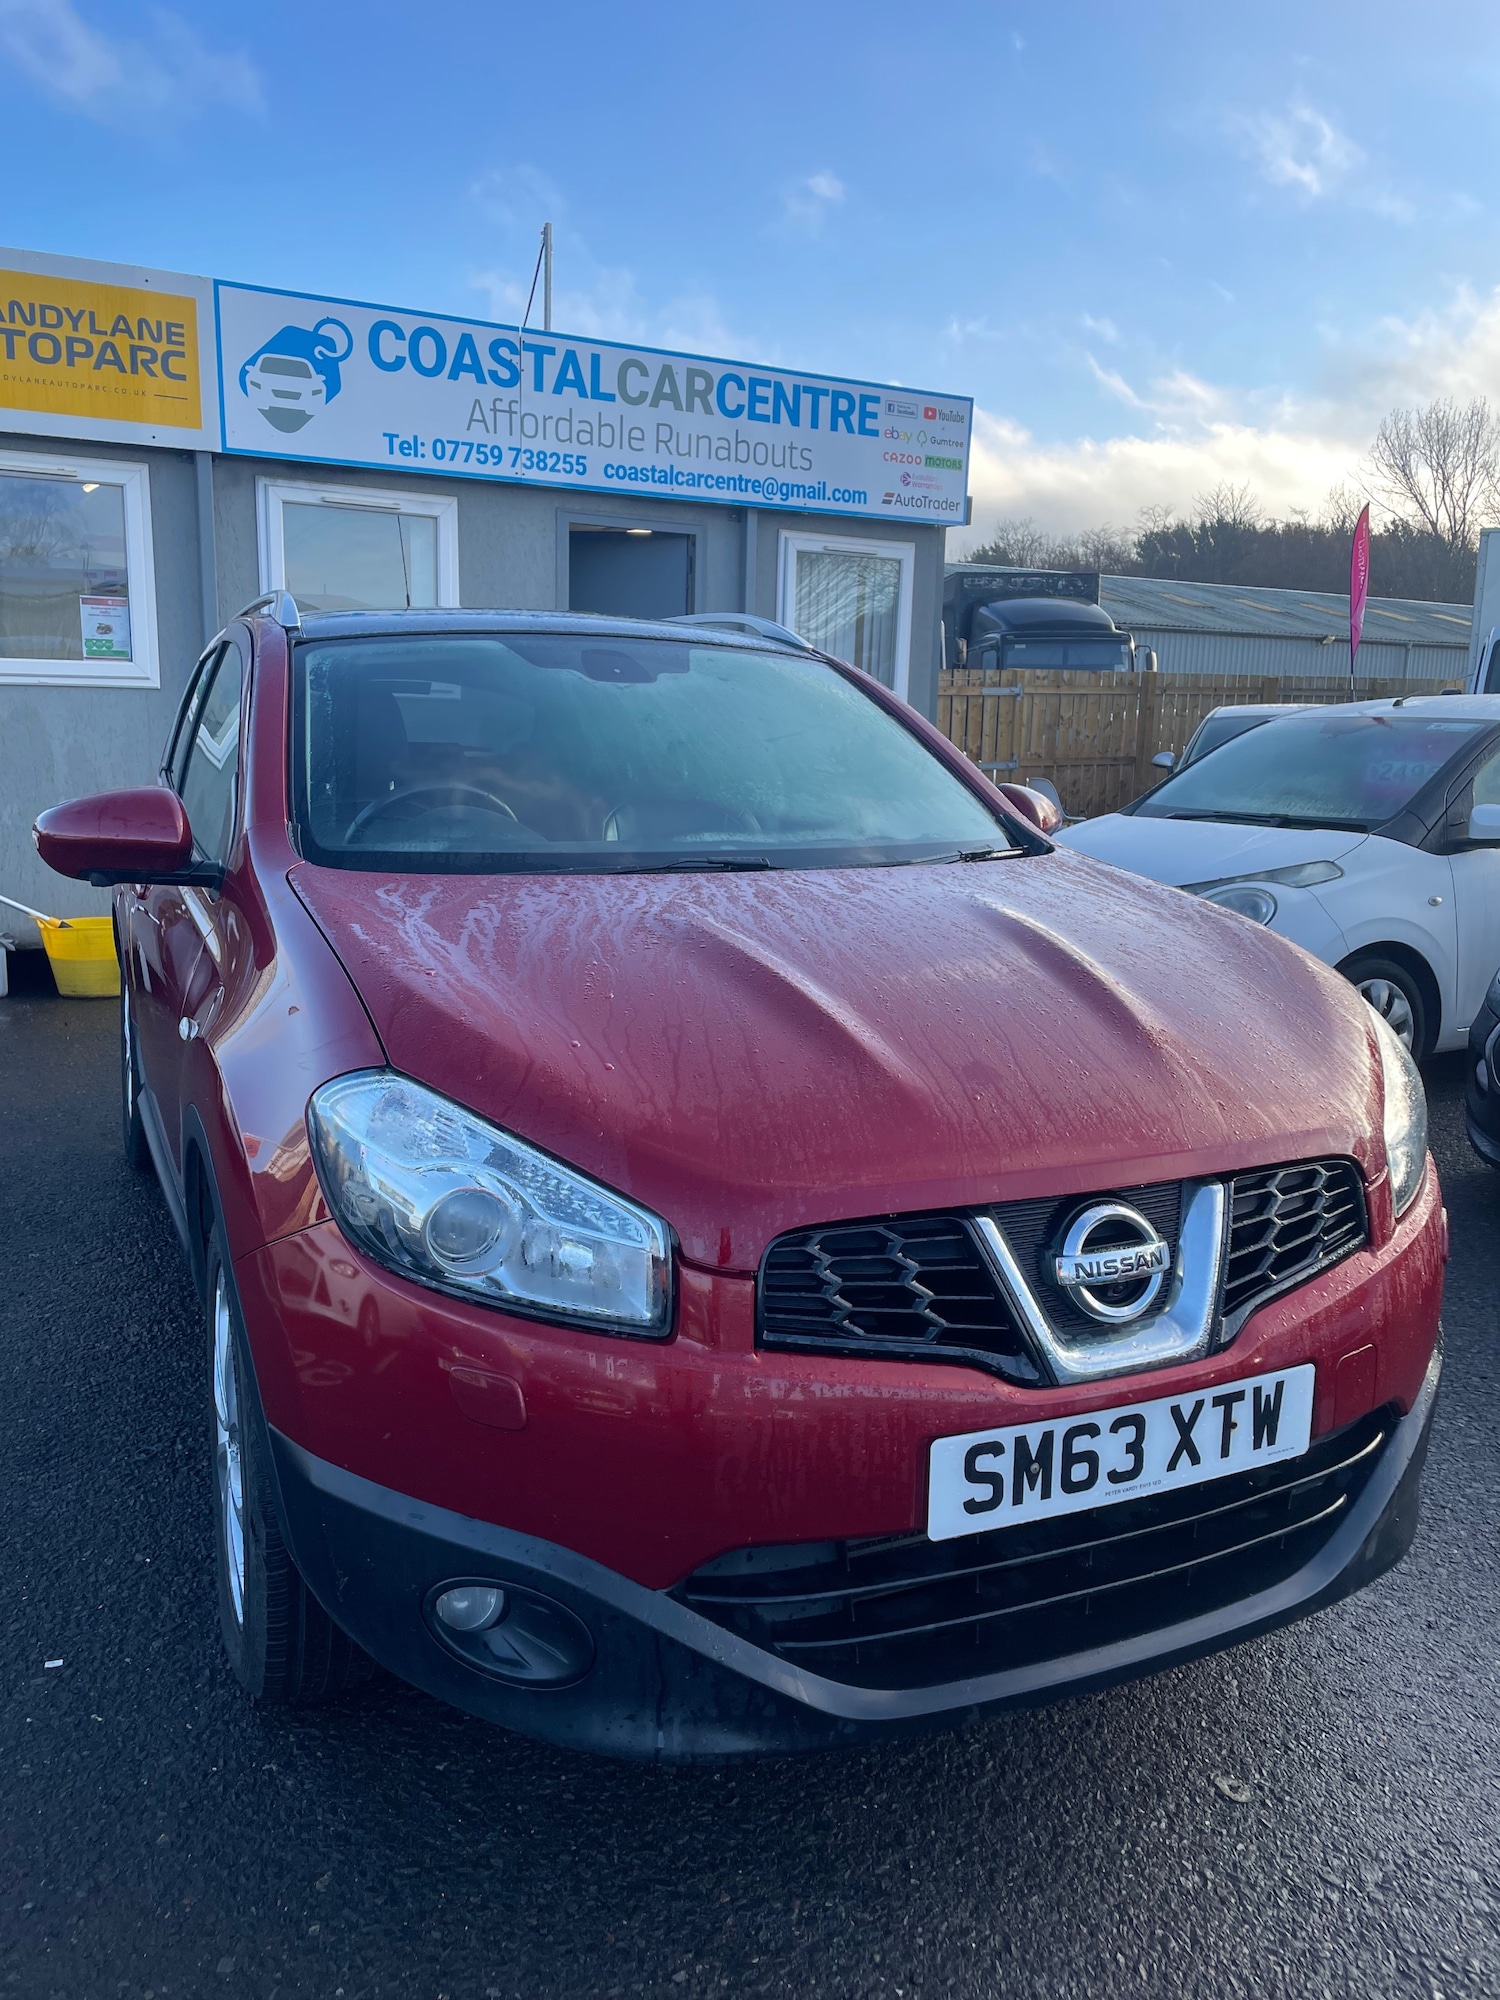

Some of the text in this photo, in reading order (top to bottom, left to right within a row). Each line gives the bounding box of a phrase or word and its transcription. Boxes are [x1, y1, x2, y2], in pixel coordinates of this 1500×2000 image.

[0, 300, 185, 346] NDYLANE
[0, 327, 187, 381] TOPARC
[368, 319, 881, 437] COASTALCARCENTRE
[466, 398, 813, 471] Affordable Runabouts
[884, 426, 913, 444] ebay
[938, 409, 965, 424] YouTube
[883, 451, 922, 465] CAZOO
[930, 436, 964, 448] Gumtree
[382, 432, 868, 505] Tel: 07759 738255 coastalcarcentre@gmail.com
[894, 493, 960, 512] AutoTrader
[1074, 1250, 1166, 1280] NISSAN
[963, 1380, 1285, 1515] SM63 XTW
